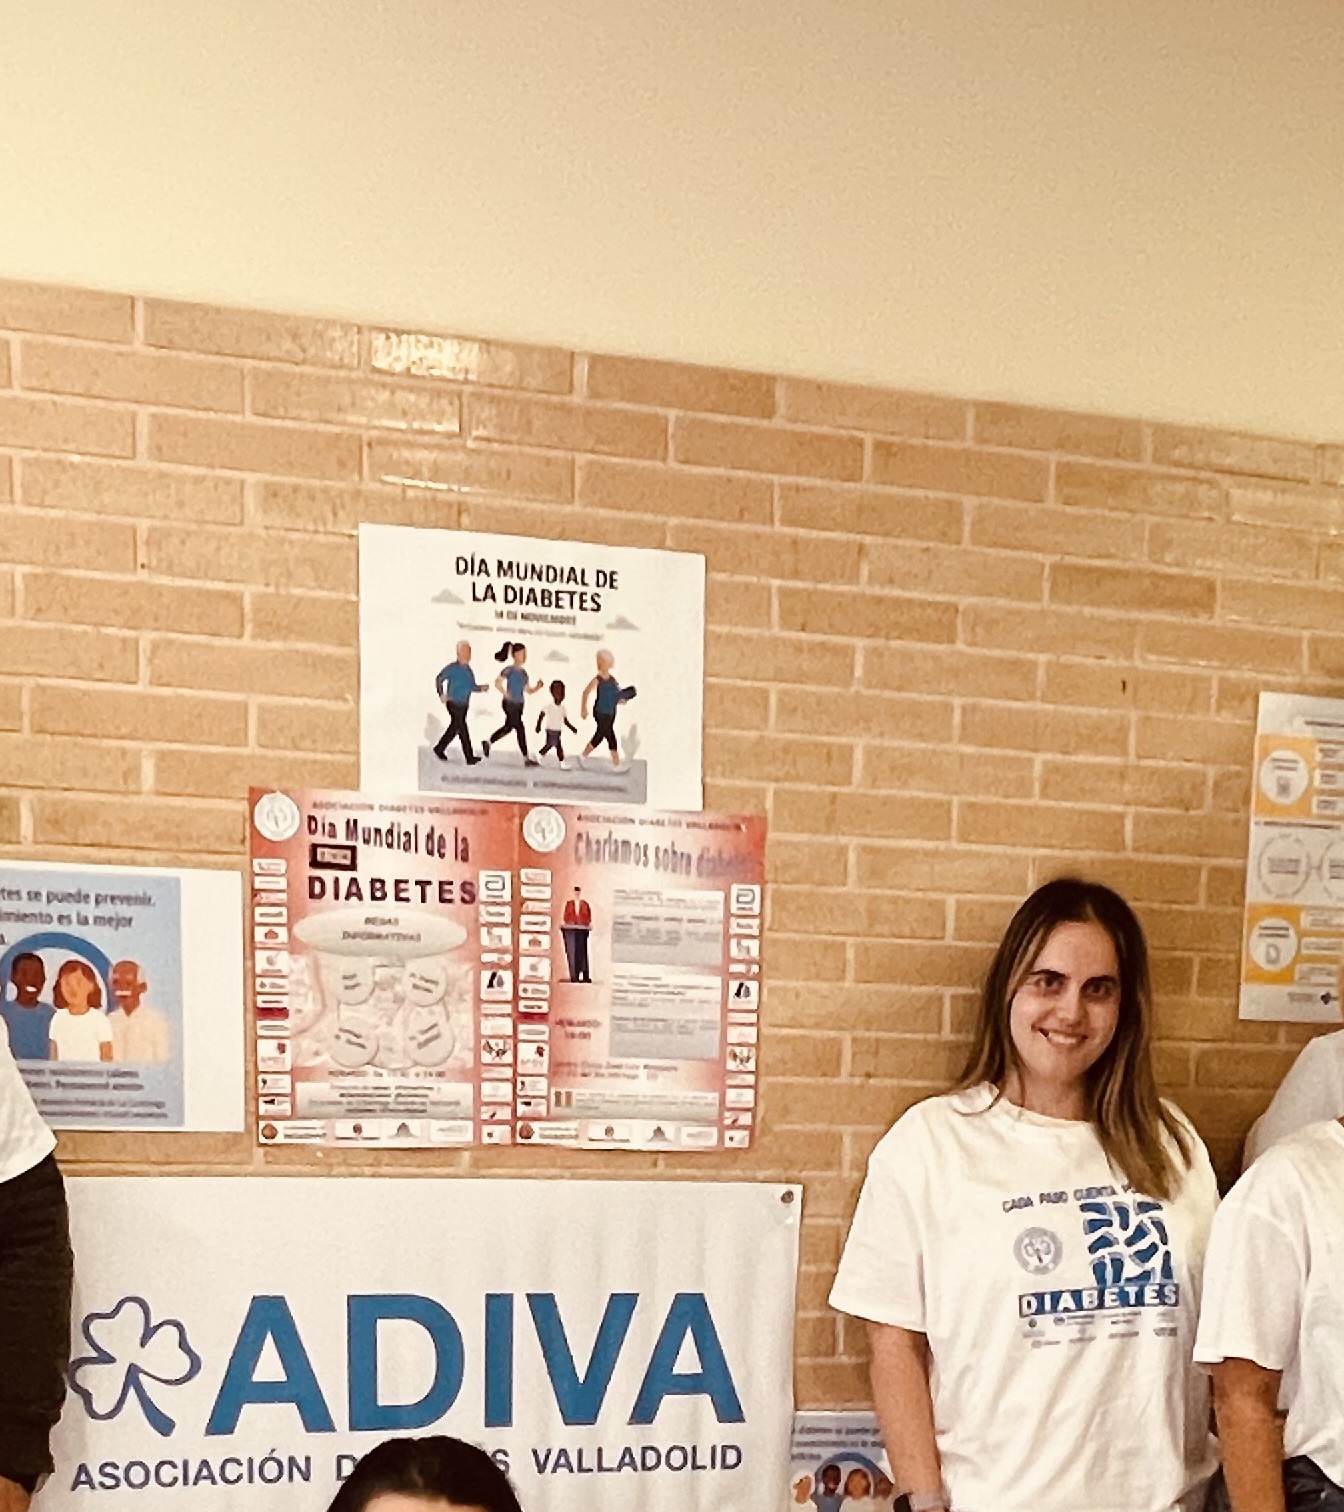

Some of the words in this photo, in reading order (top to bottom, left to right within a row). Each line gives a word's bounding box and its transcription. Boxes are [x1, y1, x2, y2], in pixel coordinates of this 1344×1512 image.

[455, 551, 490, 577] DÍA
[496, 559, 589, 587] MUNDIAL
[596, 569, 618, 590] DE
[472, 581, 496, 603] LA
[504, 584, 602, 612] DIABETES
[345, 818, 418, 854] Mundial
[425, 824, 446, 859] de
[455, 826, 470, 863] la
[26, 889, 42, 901] se
[46, 888, 90, 905] puede
[308, 875, 477, 904] DIABETES
[57, 913, 73, 926] es
[76, 911, 90, 926] la
[93, 914, 134, 931] mejor
[1020, 1284, 1178, 1316] DIABETES
[203, 1291, 746, 1437] ADIVA
[70, 1450, 313, 1492] ASOCIACIÓN
[533, 1444, 743, 1475] VALLADOLID
